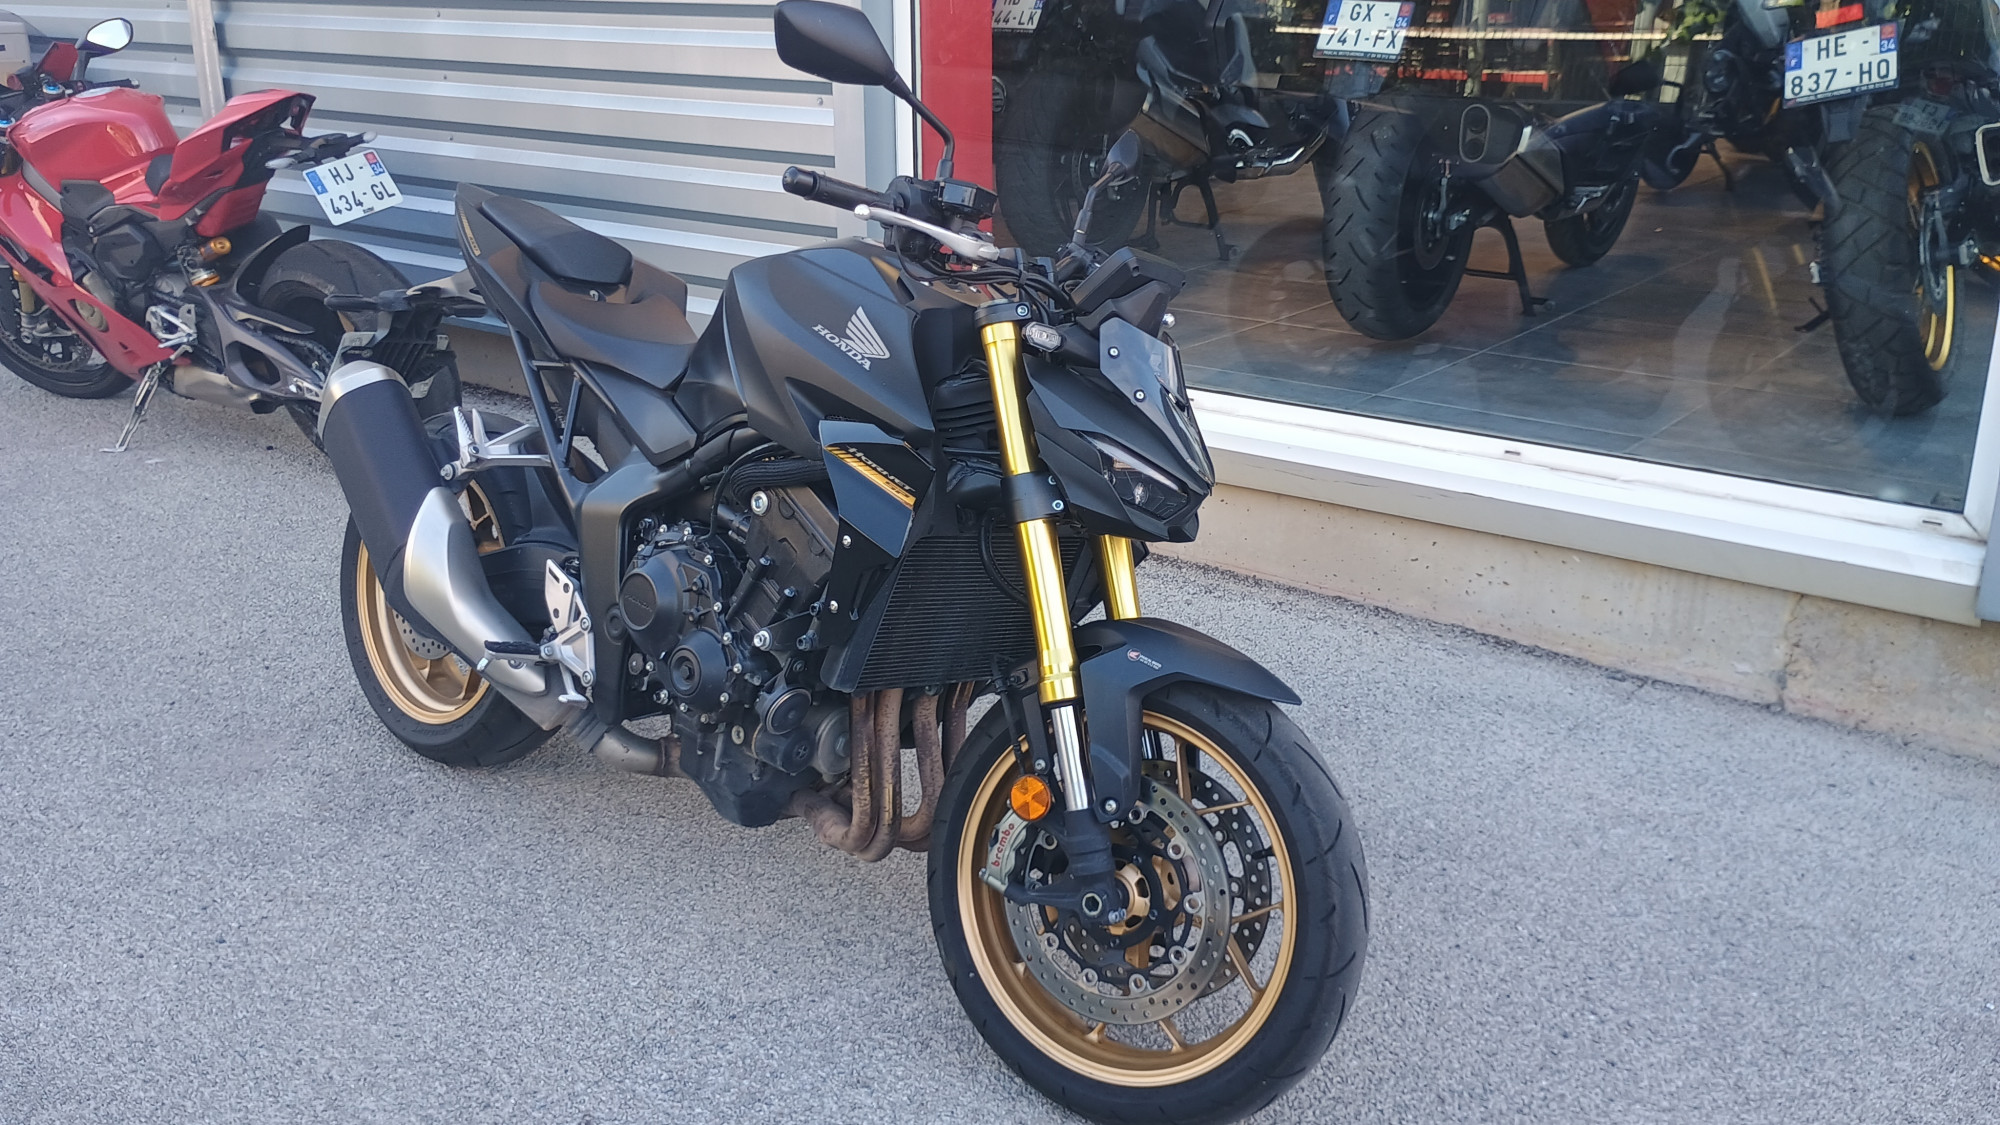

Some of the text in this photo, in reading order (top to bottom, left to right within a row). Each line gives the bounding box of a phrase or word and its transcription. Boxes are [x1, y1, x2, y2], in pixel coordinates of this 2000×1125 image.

[1396, 17, 1408, 27] 34
[1326, 28, 1400, 49] 741-FX
[1880, 38, 1896, 51] 34
[1791, 59, 1890, 96] 837-HQ
[371, 163, 384, 174] 34
[330, 181, 396, 215] 434-GL
[811, 323, 872, 371] HONDA
[991, 822, 1015, 867] brembo
